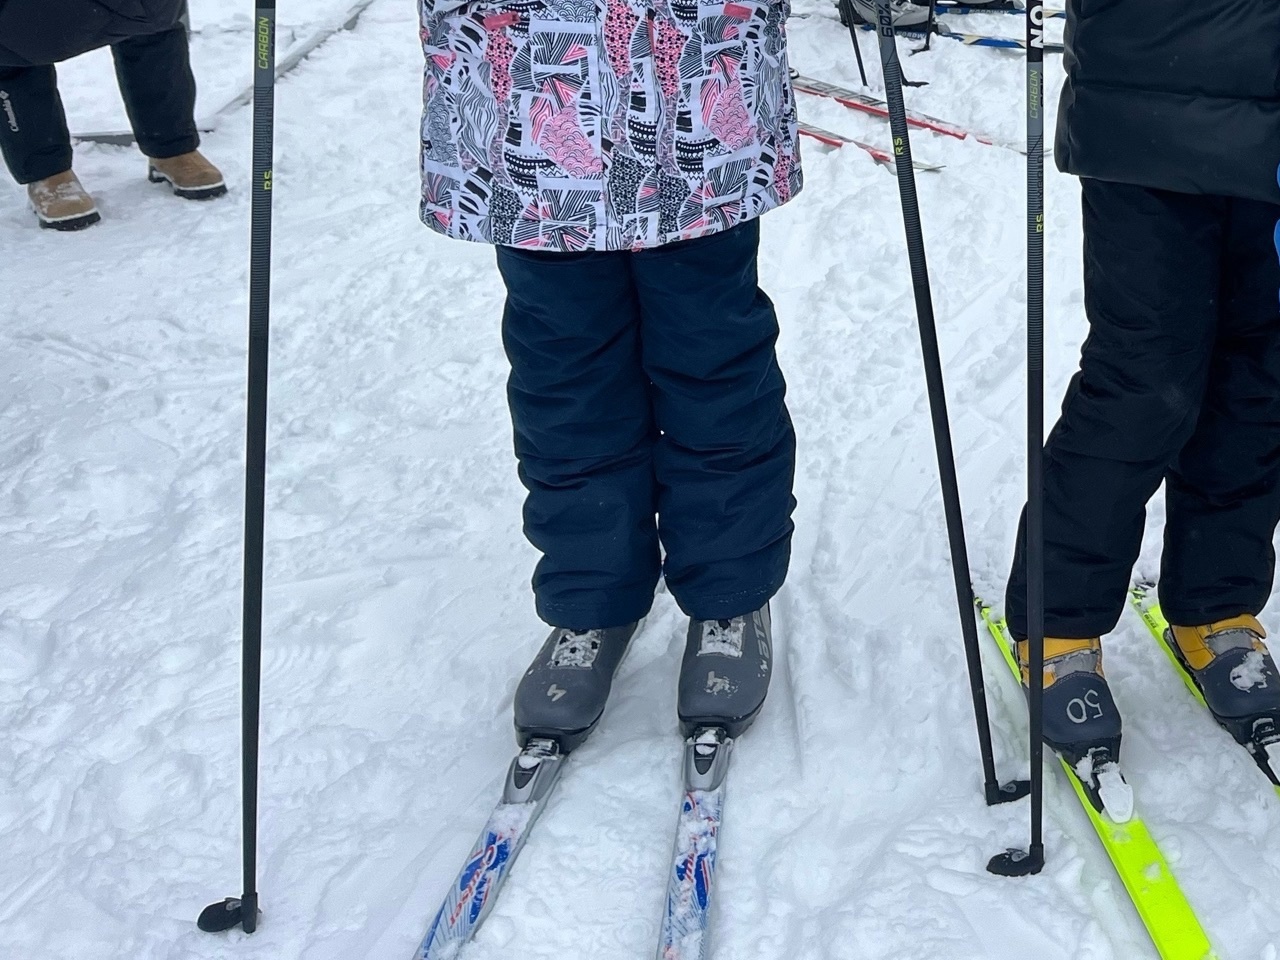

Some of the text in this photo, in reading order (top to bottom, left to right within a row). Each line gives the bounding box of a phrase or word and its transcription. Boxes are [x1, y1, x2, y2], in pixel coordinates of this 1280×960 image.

[257, 16, 270, 70] CARBON
[1029, 69, 1038, 120] CARBON
[893, 137, 904, 156] RS
